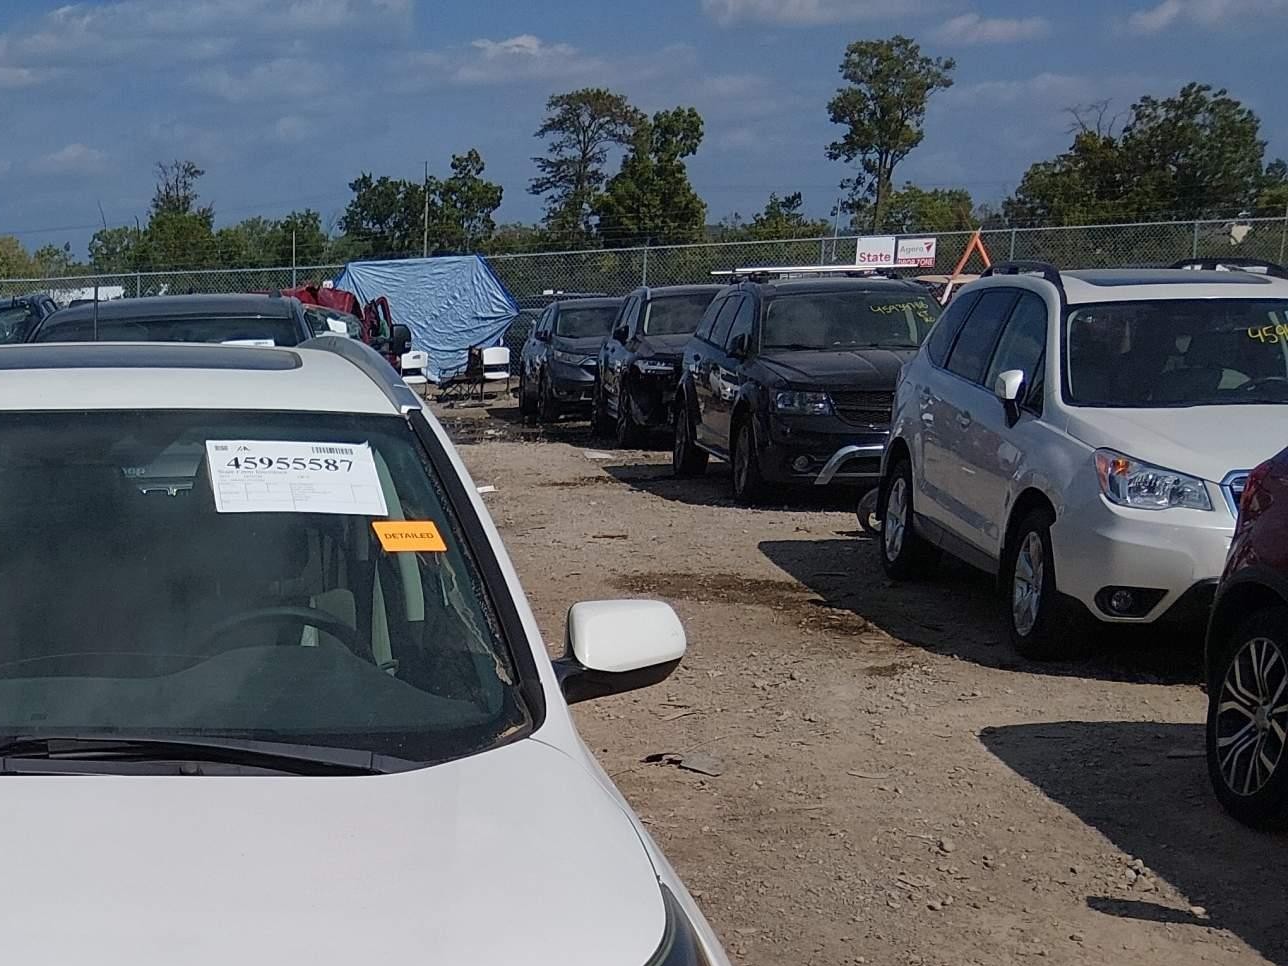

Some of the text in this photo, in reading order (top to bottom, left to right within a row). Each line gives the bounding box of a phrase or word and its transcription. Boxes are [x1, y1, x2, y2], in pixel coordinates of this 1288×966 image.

[859, 252, 891, 263] State
[226, 456, 353, 473] 45955587
[384, 532, 434, 540] DETAILED
